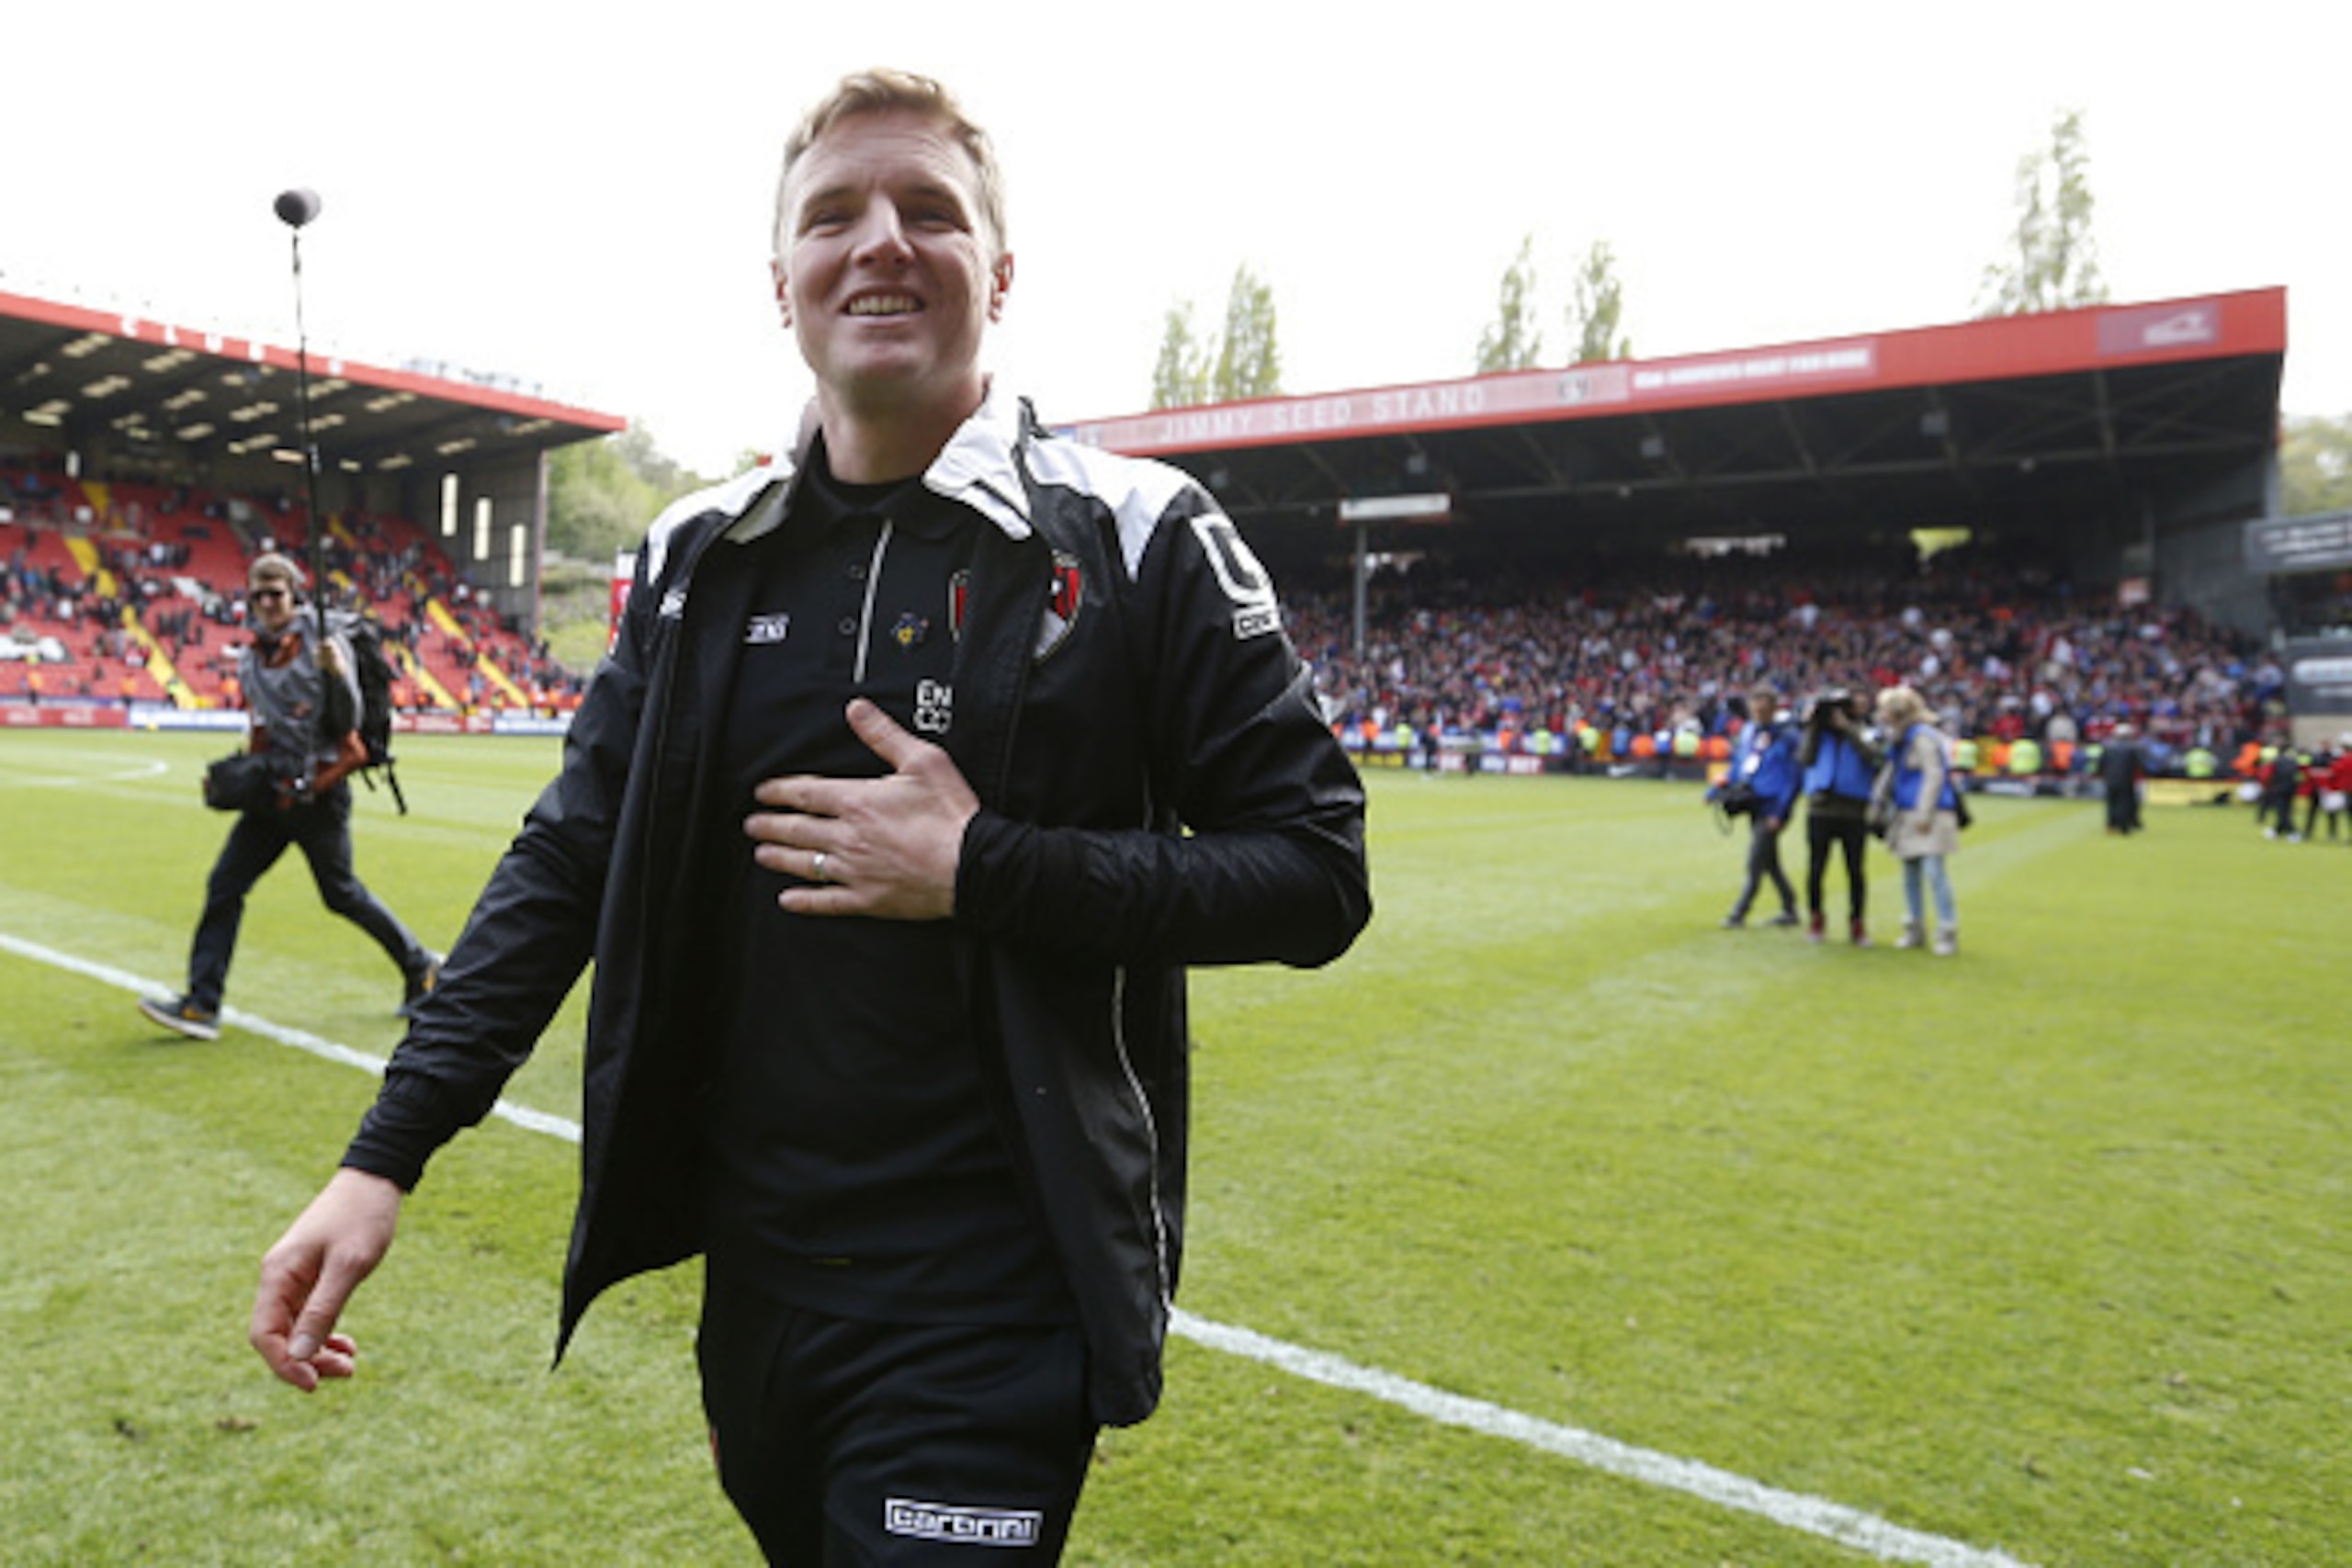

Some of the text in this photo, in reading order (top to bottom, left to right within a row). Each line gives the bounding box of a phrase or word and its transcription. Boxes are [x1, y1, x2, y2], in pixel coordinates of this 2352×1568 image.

[1159, 384, 1486, 442] JIMMY SEED STAND
